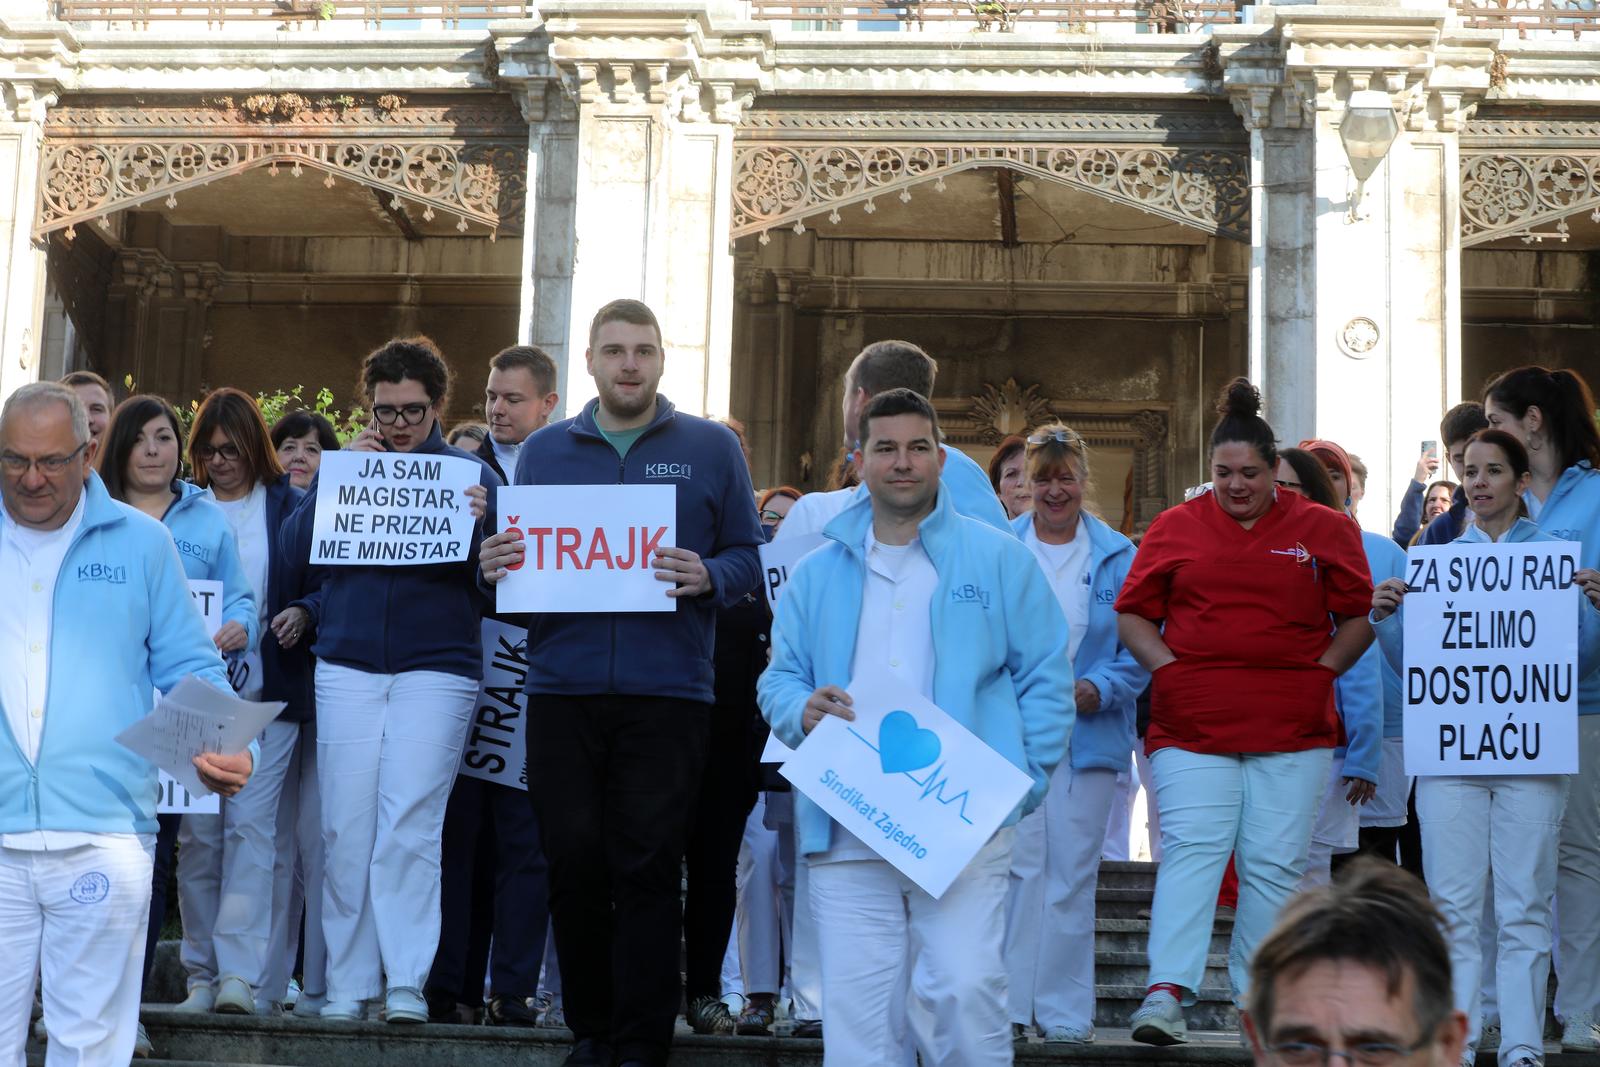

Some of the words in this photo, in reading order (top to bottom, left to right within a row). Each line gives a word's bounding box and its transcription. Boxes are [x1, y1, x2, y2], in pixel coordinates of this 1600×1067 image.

[358, 458, 386, 479] JA
[392, 460, 442, 481] SAM
[338, 485, 460, 513] MAGISTAR,
[334, 512, 365, 533] NE
[371, 514, 452, 535] PRIZNA
[318, 540, 351, 559] ME
[357, 541, 461, 560] MINISTAR
[1407, 558, 1440, 592] ZA
[1447, 556, 1514, 592] SVOJ
[1522, 554, 1575, 590] RAD
[1441, 601, 1537, 649] ŽELIMO
[1407, 663, 1572, 705] DOSTOJNU
[1439, 712, 1540, 761] PLAĆU
[820, 768, 878, 821] Sindikat
[874, 811, 928, 860] Zajedno
